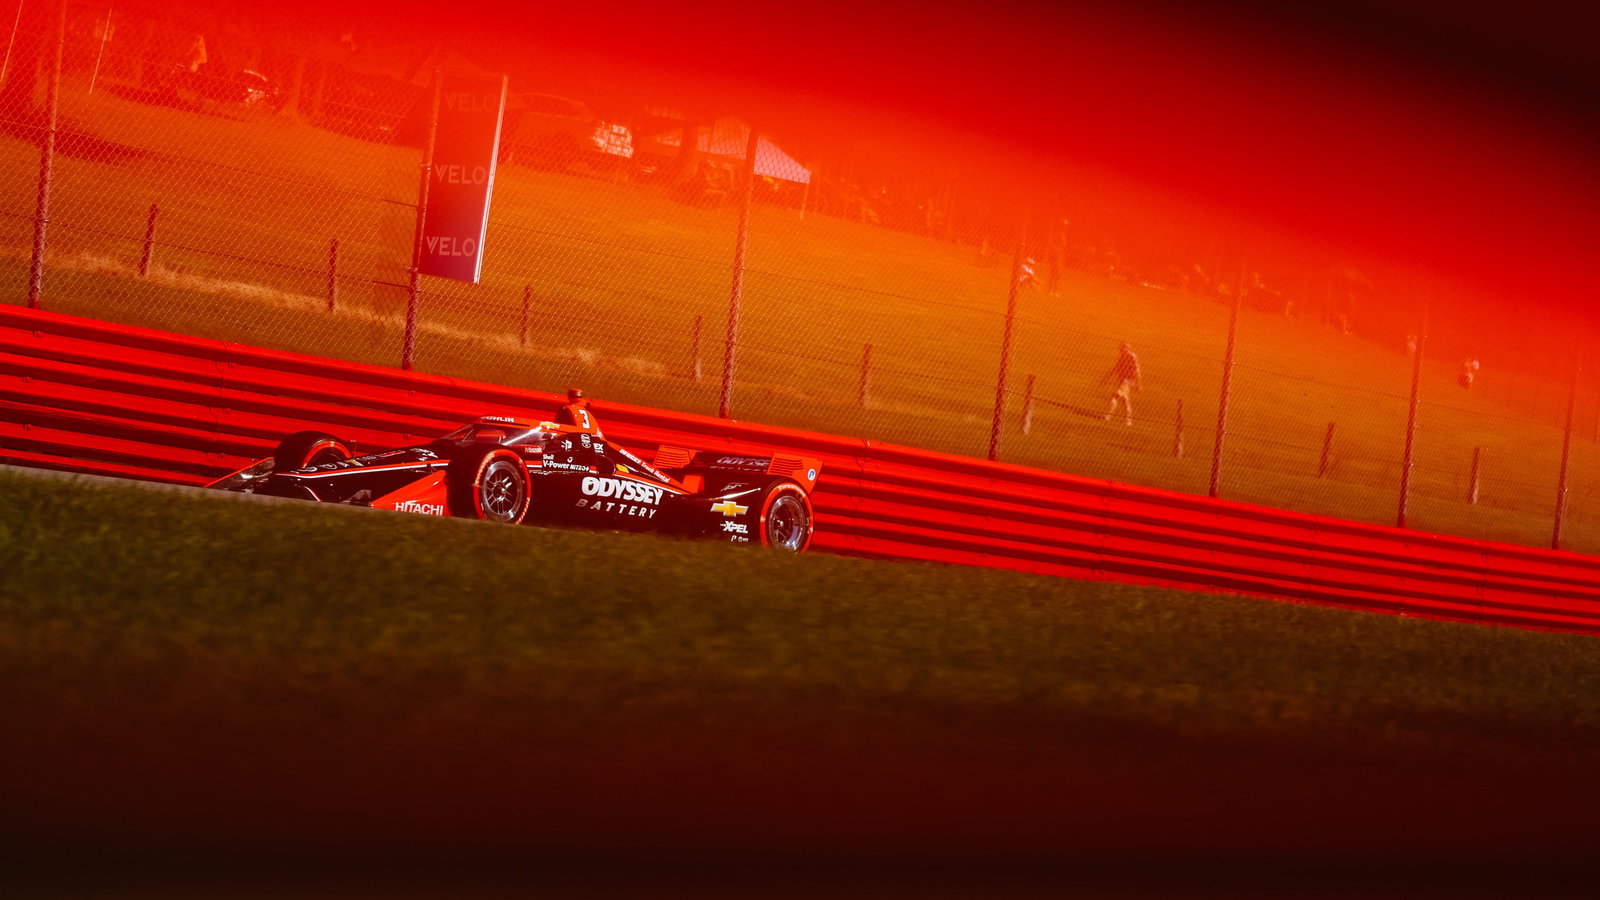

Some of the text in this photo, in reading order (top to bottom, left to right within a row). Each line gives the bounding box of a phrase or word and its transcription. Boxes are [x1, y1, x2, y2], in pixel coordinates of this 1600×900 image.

[444, 92, 499, 113] VELO
[434, 163, 487, 185] VELO
[425, 235, 476, 257] VELO
[578, 409, 590, 429] 3
[543, 460, 569, 469] V-Power
[581, 476, 664, 505] ODYSSEY
[395, 501, 444, 516] HITACHI
[575, 498, 657, 519] BATTERY
[722, 520, 749, 534] XPEL
